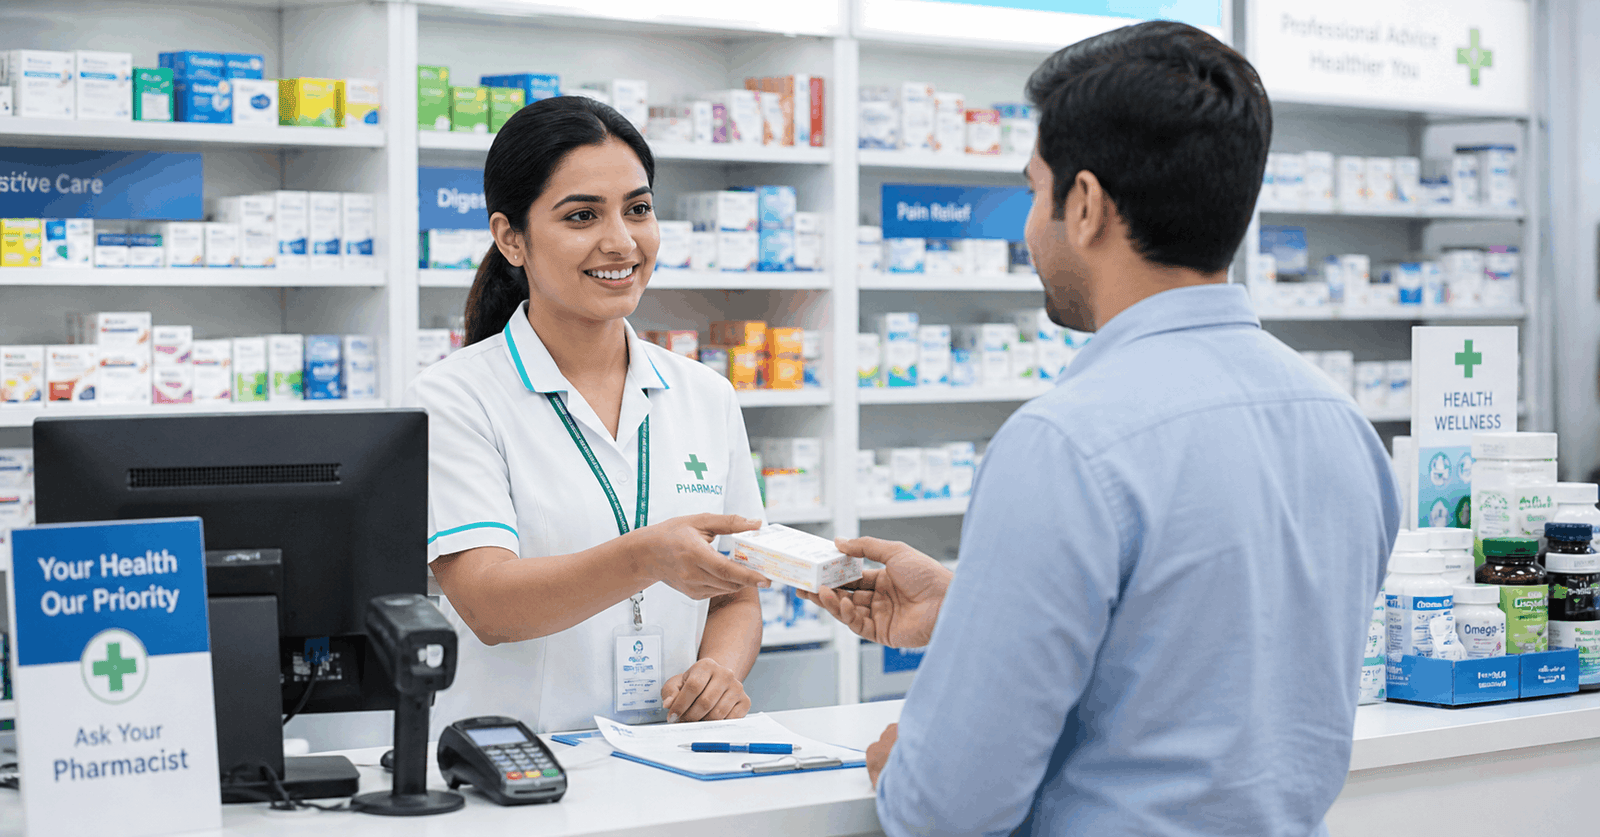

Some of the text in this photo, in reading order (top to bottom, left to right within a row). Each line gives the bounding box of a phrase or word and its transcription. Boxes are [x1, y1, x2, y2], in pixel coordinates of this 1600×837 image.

[56, 173, 104, 194] Care
[897, 201, 972, 222] Pain Relief
[1443, 391, 1493, 408] HEALTH
[1434, 414, 1502, 431] WELLNESS
[676, 483, 723, 496] PHARMACY
[38, 549, 177, 581] Your Health
[41, 584, 180, 616] Our Priority
[74, 722, 163, 747] Ask Your
[53, 748, 189, 781] Pharmacist
